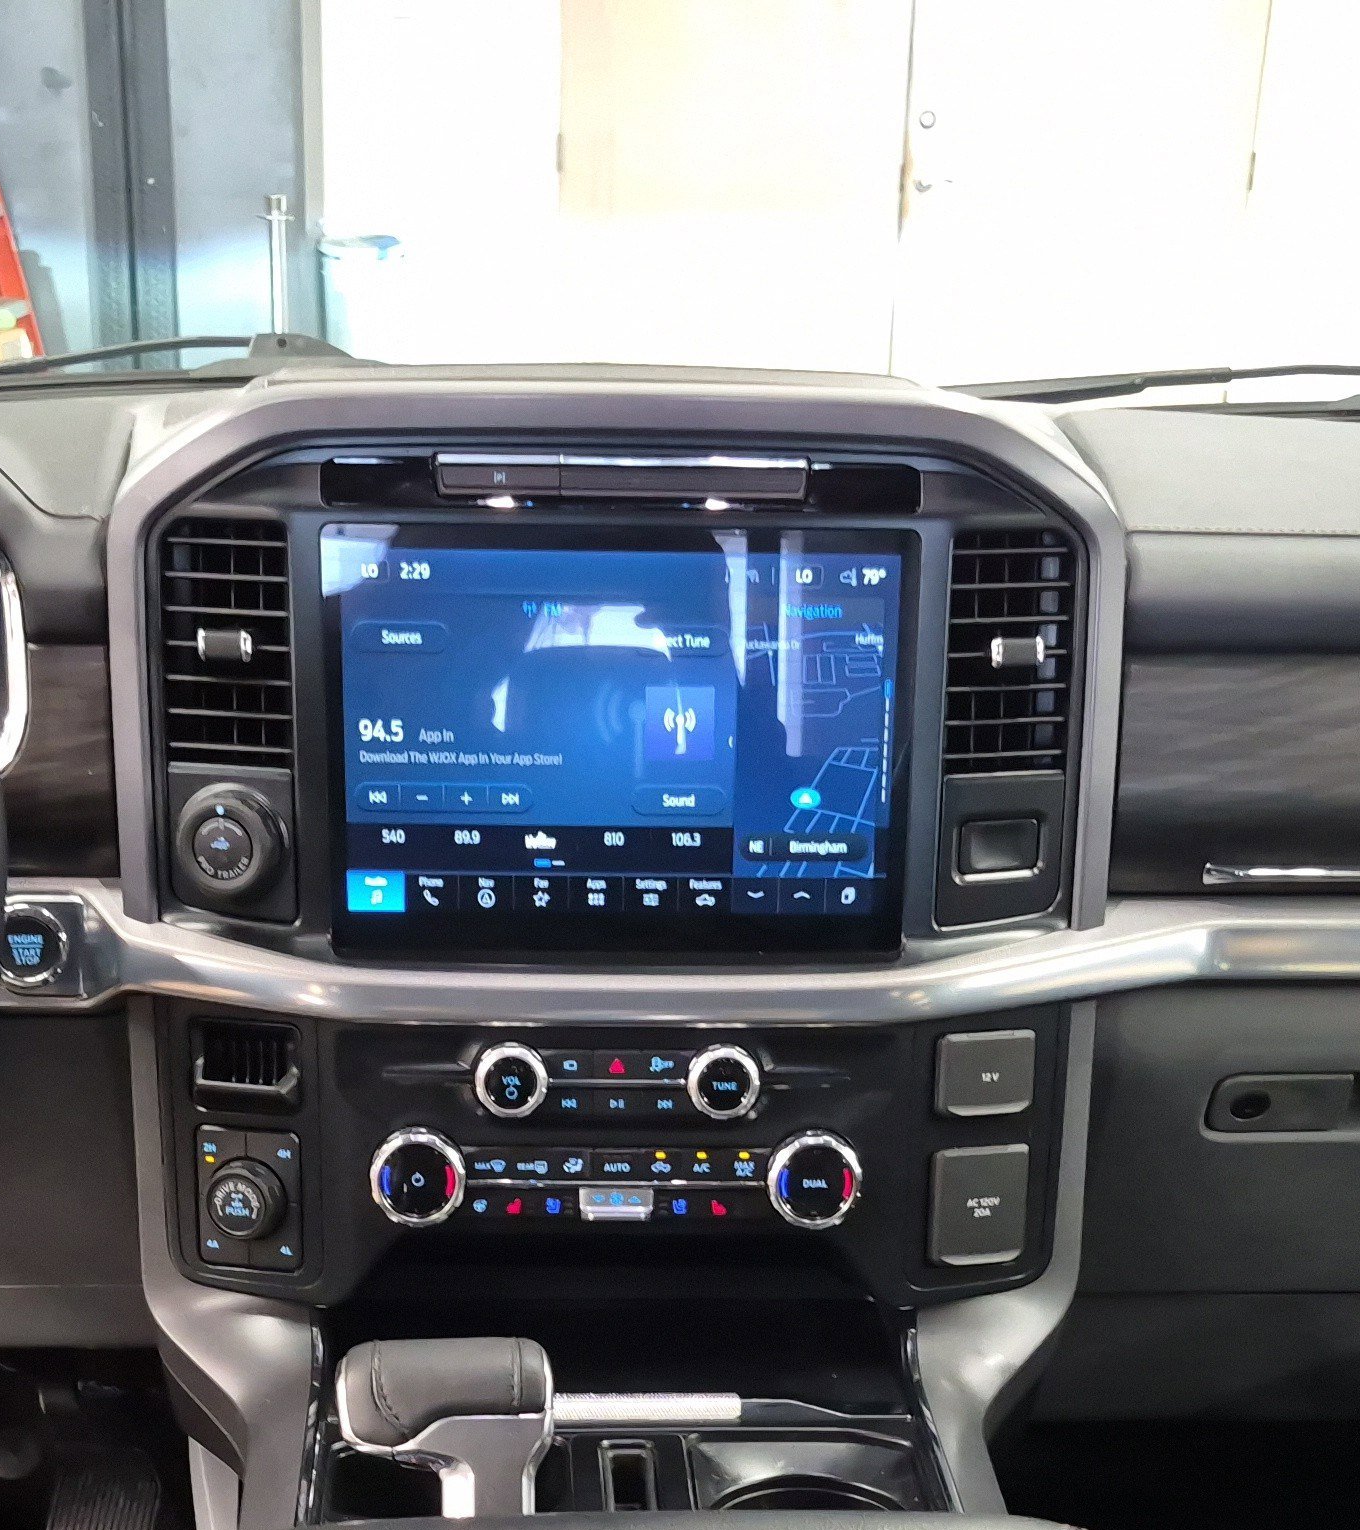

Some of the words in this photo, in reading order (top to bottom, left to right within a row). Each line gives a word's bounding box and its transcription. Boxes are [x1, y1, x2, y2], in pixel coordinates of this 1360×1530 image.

[399, 562, 431, 580] 2:29
[795, 568, 813, 584] LO
[785, 603, 842, 618] Navigation
[381, 630, 423, 645] Sources
[684, 635, 710, 649] Tune
[358, 719, 404, 742] 94.5
[418, 729, 441, 744] App
[442, 730, 455, 744] In
[359, 750, 408, 765] Download
[409, 750, 428, 765] The
[429, 751, 457, 765] WJOX
[458, 752, 478, 767] App
[490, 752, 512, 766] Your
[513, 753, 533, 767] App
[534, 753, 563, 767] Store!
[662, 793, 696, 808] Sound
[381, 828, 406, 844] 540
[453, 829, 481, 845] 89.9
[603, 831, 625, 847] 810
[671, 832, 702, 847] 106.3
[789, 840, 848, 855] Birmingham
[217, 856, 249, 879] TRAILER
[418, 876, 444, 888] Phone
[477, 877, 495, 888] Nav
[635, 878, 668, 891] Settings
[688, 879, 723, 891] Features
[7, 934, 44, 944] ENGINE
[501, 1075, 521, 1087] VOL
[712, 1081, 739, 1092] TUNE
[603, 1162, 631, 1173] AUTO
[693, 1162, 711, 1174] A/C
[802, 1178, 829, 1189] DUAL
[214, 1181, 236, 1206] DRIVE
[236, 1182, 260, 1209] MODE
